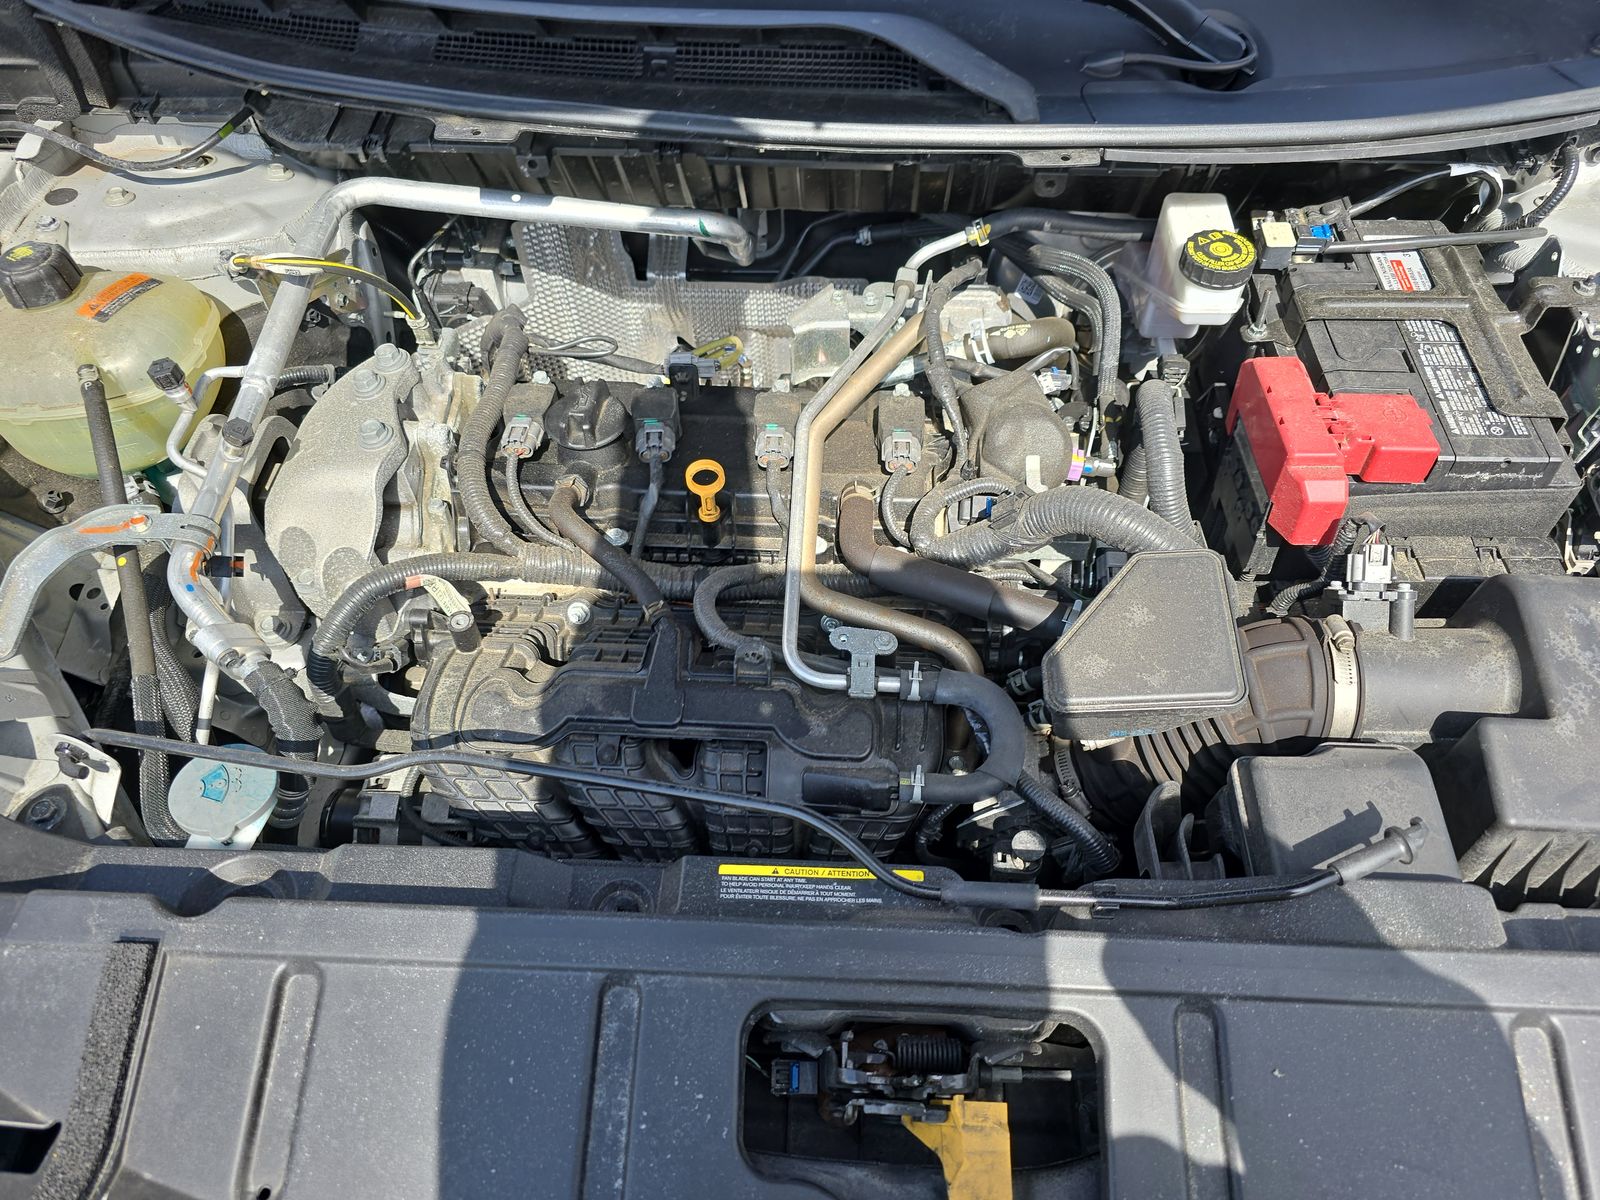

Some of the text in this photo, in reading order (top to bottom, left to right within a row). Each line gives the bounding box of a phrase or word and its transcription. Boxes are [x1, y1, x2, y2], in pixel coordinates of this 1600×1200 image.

[84, 382, 92, 390] P
[784, 868, 819, 876] CAUTION
[827, 869, 870, 877] ATTENTION
